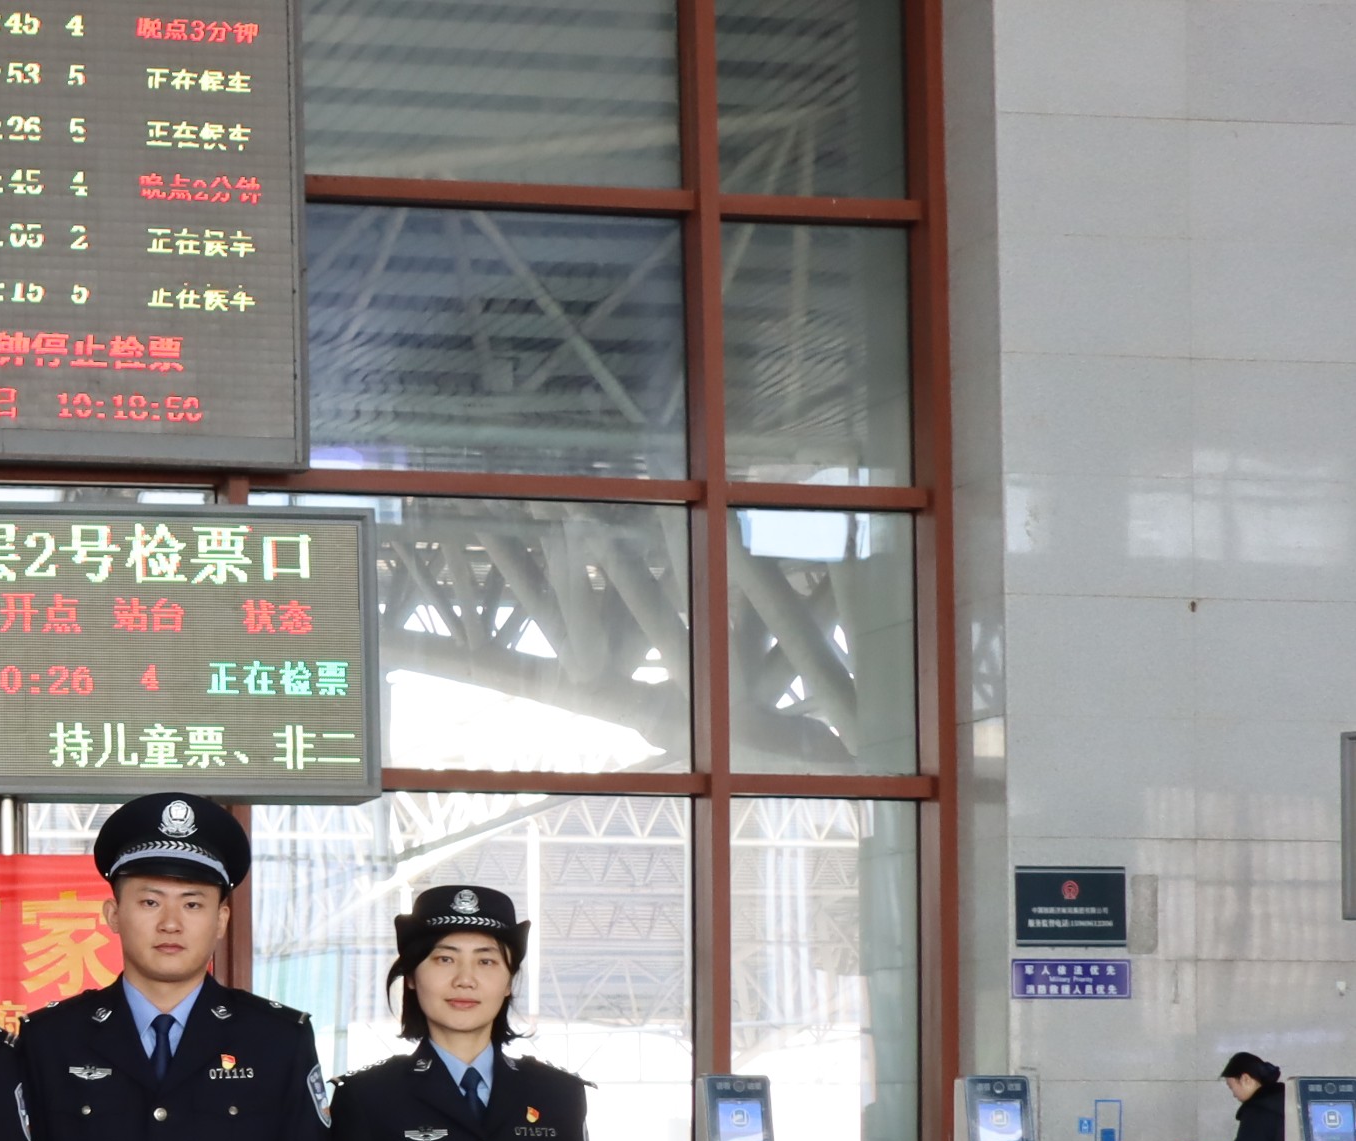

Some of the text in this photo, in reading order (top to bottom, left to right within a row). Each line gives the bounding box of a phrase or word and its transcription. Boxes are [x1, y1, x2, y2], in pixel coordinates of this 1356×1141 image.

[65, 15, 84, 37] 4
[135, 17, 259, 44] 晚点3分钟
[146, 68, 251, 93] 正在候车
[146, 121, 251, 151] 正在候车
[69, 171, 88, 197] 4
[70, 225, 89, 250] 2
[146, 228, 256, 258] 正在候车
[147, 283, 256, 312] 正在候车
[0, 592, 82, 634] 开点
[113, 597, 185, 633] 站台
[242, 599, 313, 635] 状态
[140, 664, 159, 691] 4
[206, 660, 349, 697] 正在检票
[48, 721, 361, 771] 持儿童票、非二
[1024, 965, 1116, 976] 军人依法优先
[209, 1068, 254, 1079] 071113
